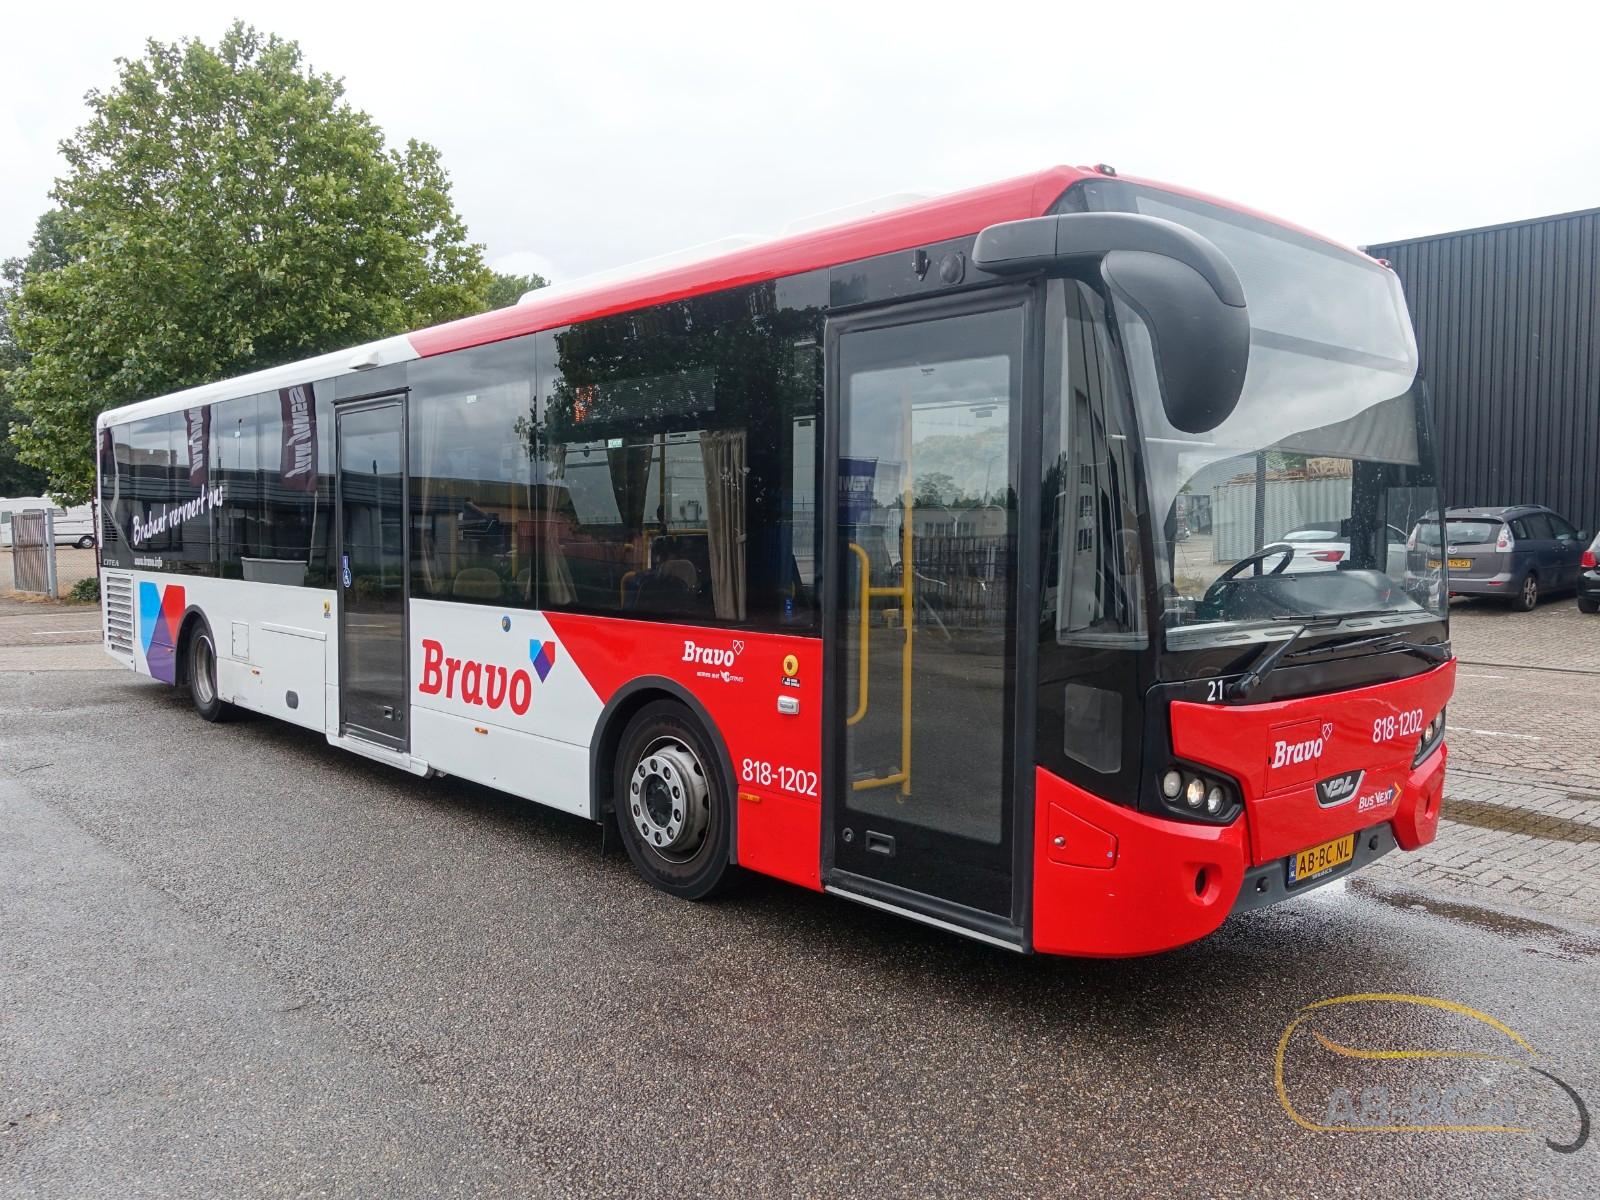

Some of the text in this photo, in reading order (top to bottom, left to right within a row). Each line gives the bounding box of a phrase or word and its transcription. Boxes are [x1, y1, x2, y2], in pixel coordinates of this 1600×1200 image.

[133, 483, 223, 546] Brabant vervoert ons
[682, 640, 735, 667] Bravo
[419, 639, 532, 715] Bravo
[1207, 679, 1223, 701] 21
[1372, 708, 1423, 743] 818-1202
[1271, 738, 1323, 769] Bravo
[742, 758, 818, 797] 818-1202
[1322, 775, 1354, 798] VDL
